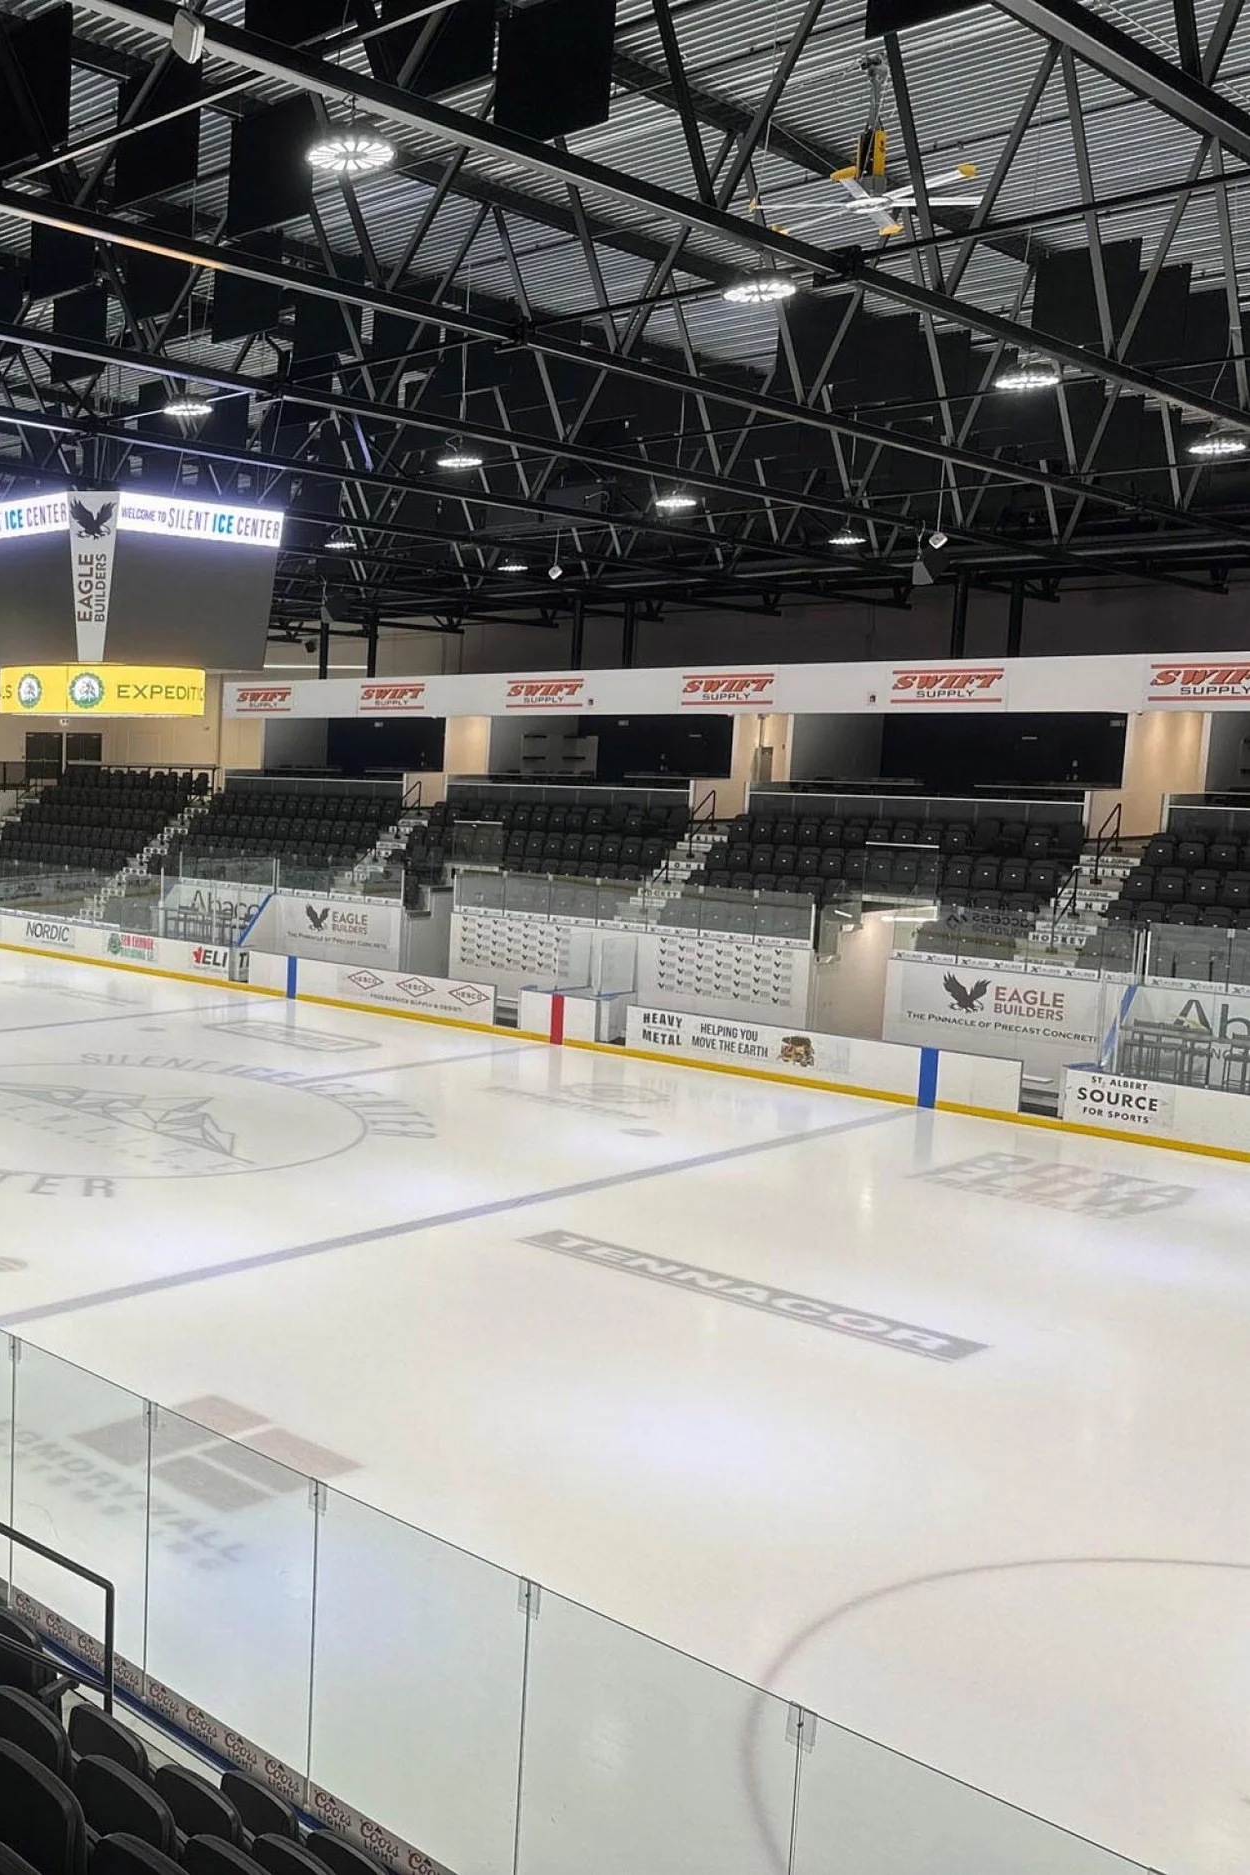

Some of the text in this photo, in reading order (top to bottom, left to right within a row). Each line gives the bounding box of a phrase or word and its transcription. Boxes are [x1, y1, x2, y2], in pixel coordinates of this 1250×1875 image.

[5, 509, 23, 530] ICE
[27, 503, 67, 527] CENTER
[121, 506, 279, 539] WELCOME TO SILENT ICE CENTER
[77, 554, 93, 622] EAGLE
[95, 553, 107, 622] BUILDERS
[682, 679, 773, 694] SWIFT
[892, 674, 1003, 690] SWIFT
[1150, 669, 1250, 686] SWIF
[237, 691, 291, 702] SWIFT
[360, 688, 425, 700] SWIFT
[506, 683, 583, 697] SWIFT
[523, 695, 564, 704] SUPPLY
[702, 692, 750, 701] SUPPLY
[916, 689, 975, 698] SUPPLY
[249, 701, 278, 709] SUPPLY
[375, 699, 409, 707] SUPPLY
[332, 911, 368, 926] EAGLE
[26, 921, 70, 942] NORDIC
[332, 924, 367, 935] BUILDERS
[994, 986, 1065, 1009] EAGLE
[643, 1013, 683, 1029] HEAVY
[907, 1010, 926, 1021] THE
[928, 1014, 976, 1027] PINNACLE
[994, 1022, 1041, 1036] PRECAST
[994, 1003, 1064, 1022] BUILDERS
[642, 1029, 682, 1046] METAL
[701, 1023, 758, 1042] HELPING YOU
[691, 1036, 768, 1058] MOVE THE EARTH
[1110, 1079, 1147, 1091] ALBERT
[1077, 1087, 1158, 1111] SOURCE
[1083, 1106, 1149, 1124] FOR SPORTS
[560, 1237, 951, 1350] TENNACOR
[150, 1681, 180, 1712] Coors
[151, 1700, 175, 1720] LIGHT
[186, 1704, 218, 1738] Coors
[189, 1723, 214, 1745] LIGHT
[224, 1730, 258, 1765] Coors
[227, 1749, 253, 1772] LIGHT
[264, 1756, 300, 1794] Coors
[267, 1775, 295, 1800] LIGHT
[314, 1789, 351, 1827] Coors
[318, 1809, 347, 1835] LIGHT
[360, 1818, 399, 1858] Coors
[364, 1839, 394, 1865] LIGHT
